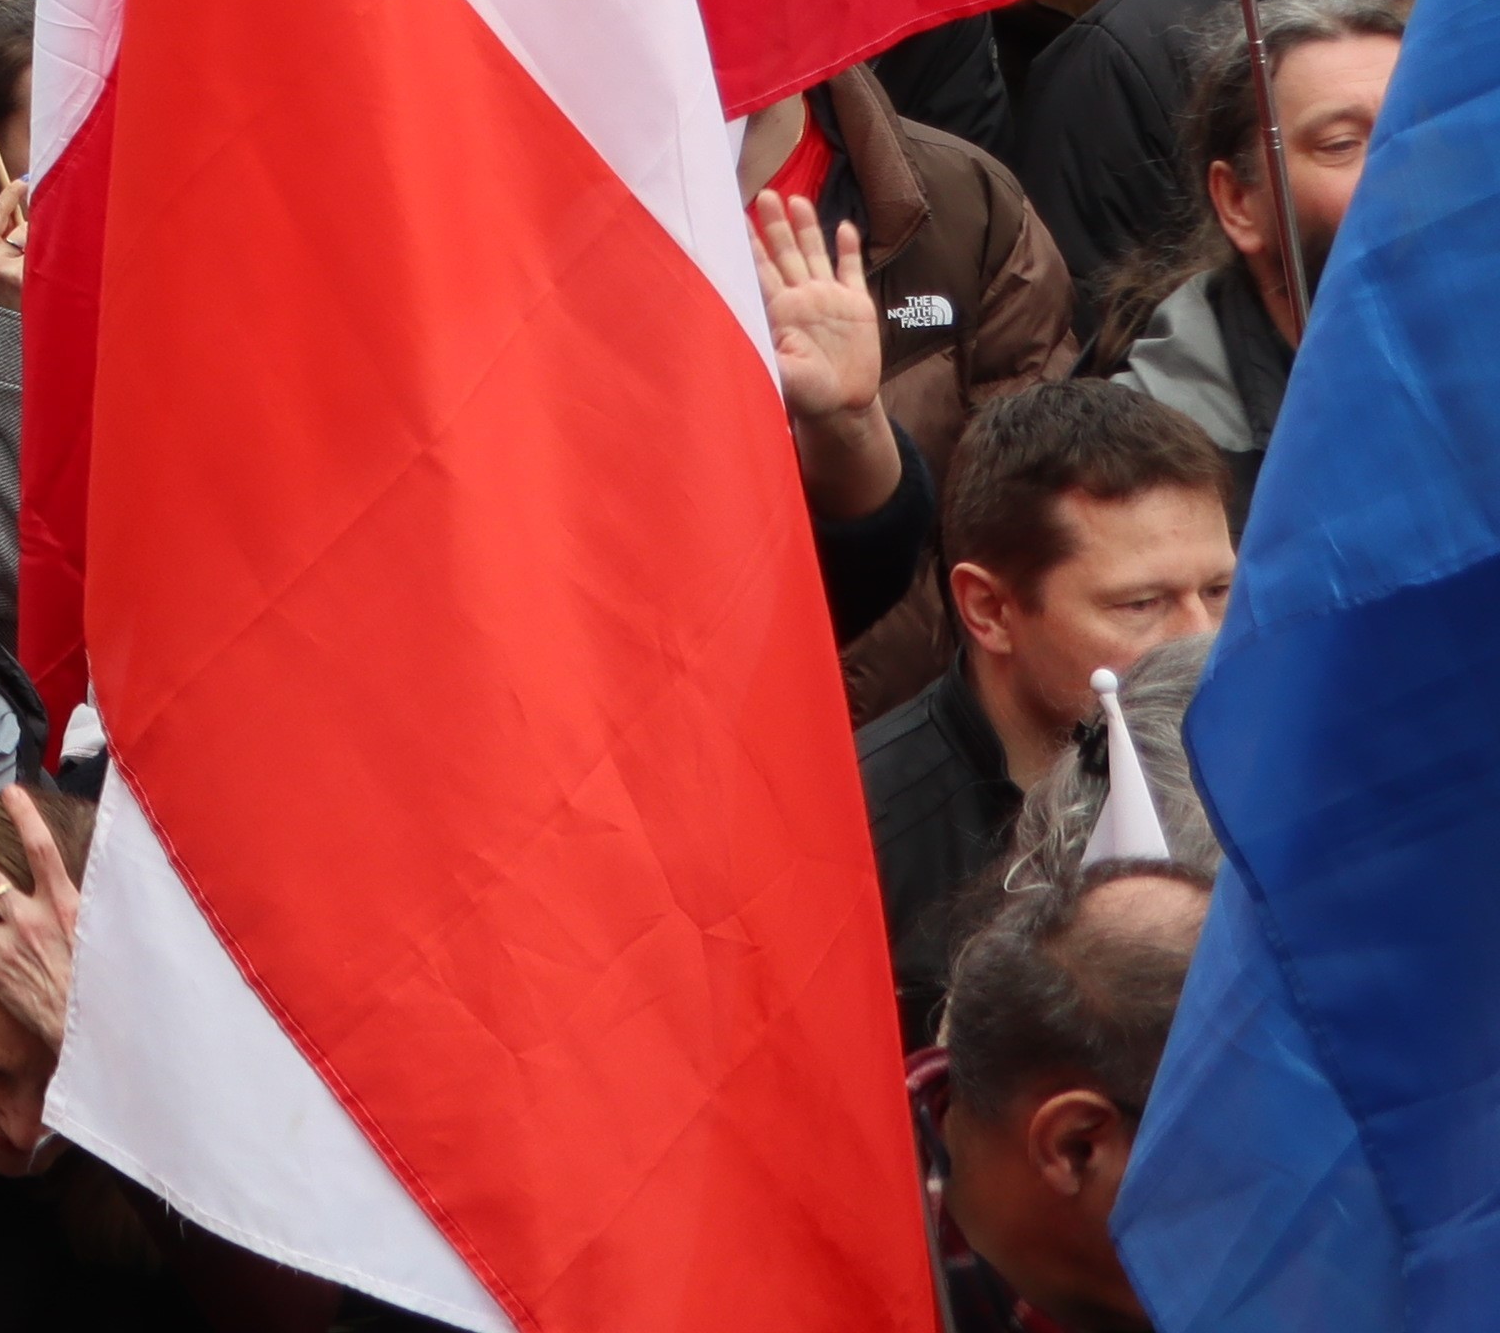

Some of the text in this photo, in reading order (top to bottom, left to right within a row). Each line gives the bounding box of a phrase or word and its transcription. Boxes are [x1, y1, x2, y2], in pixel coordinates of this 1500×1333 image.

[904, 294, 931, 308] THE
[886, 305, 932, 321] NORTH
[900, 315, 931, 329] FACE
